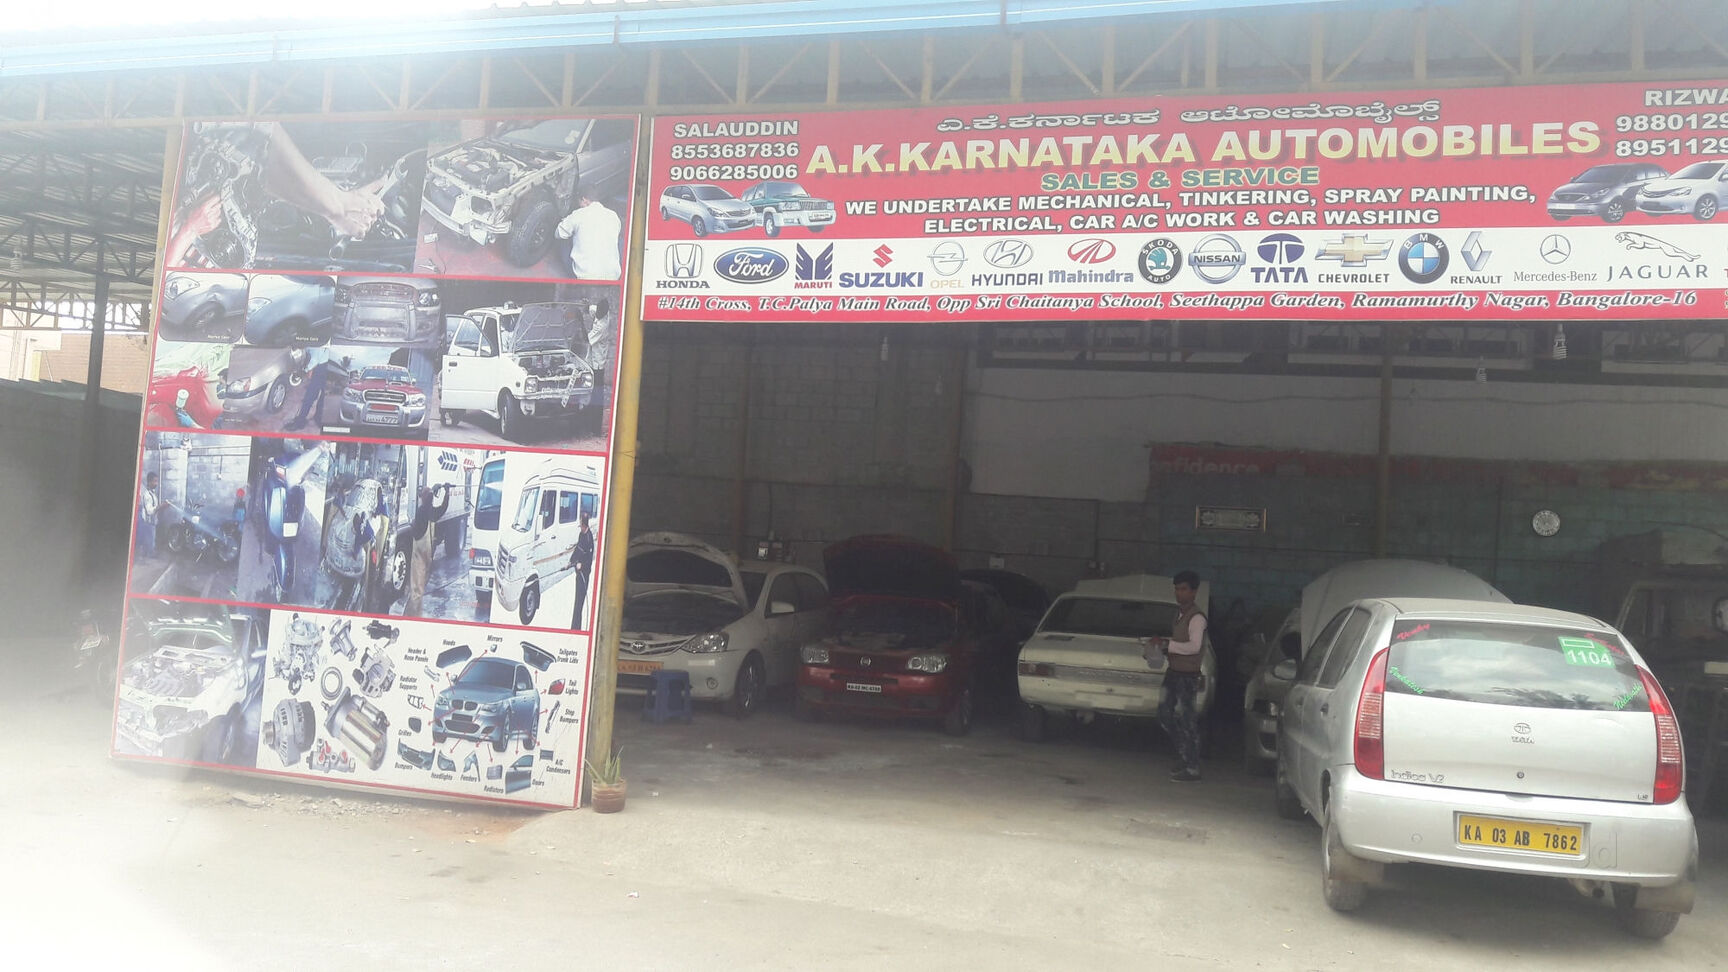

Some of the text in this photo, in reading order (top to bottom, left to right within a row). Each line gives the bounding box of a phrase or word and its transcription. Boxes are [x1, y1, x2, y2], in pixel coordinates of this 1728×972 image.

[673, 120, 799, 139] SALAUDDIN
[670, 141, 800, 160] 8553687836
[806, 121, 1602, 174] A.K.KARNATAKA AUTOMOBILES
[669, 163, 799, 181] 9066285006
[1041, 166, 1321, 191] SALES & SERVICE
[846, 185, 1536, 215] WE UNDERTAKE MECHANICAL, TINKERING, SPRAY PAINTING,
[924, 208, 1441, 234] ELECTRICAL, CAR A/C WORK & CAR WASHING
[728, 252, 775, 278] Ford
[1193, 253, 1242, 265] NISSAN
[839, 272, 924, 288] SUZUKI
[971, 273, 1043, 287] HYUNDAI
[1048, 269, 1135, 284] Mahindra
[1147, 274, 1171, 283] AUTO
[1250, 267, 1309, 283] TATA
[1318, 273, 1391, 284] CHEVROLET
[1450, 275, 1503, 285] RENAULT
[1513, 270, 1598, 283] Mercedes-Benz
[1606, 264, 1709, 283] JAGUAR
[656, 280, 711, 289] HONDA
[794, 281, 833, 289] MARUTI
[930, 279, 965, 289] OPEL
[658, 297, 701, 311] #14th
[705, 297, 752, 312] Cross,
[837, 297, 881, 311] Main
[884, 296, 931, 312] Road,
[936, 296, 971, 313] Opp
[974, 295, 1001, 309] Sri
[1006, 294, 1094, 312] Chaitanya
[1098, 294, 1164, 309] School,
[1170, 293, 1264, 311] Seethappa
[1270, 293, 1345, 309] Garden,
[1352, 292, 1479, 310] Ramamurthy
[1484, 292, 1550, 310] Nagar,
[1556, 290, 1697, 310] Bangalore-16
[1567, 650, 1612, 666] 1104
[1464, 824, 1578, 850] KA 03 AB 7862
